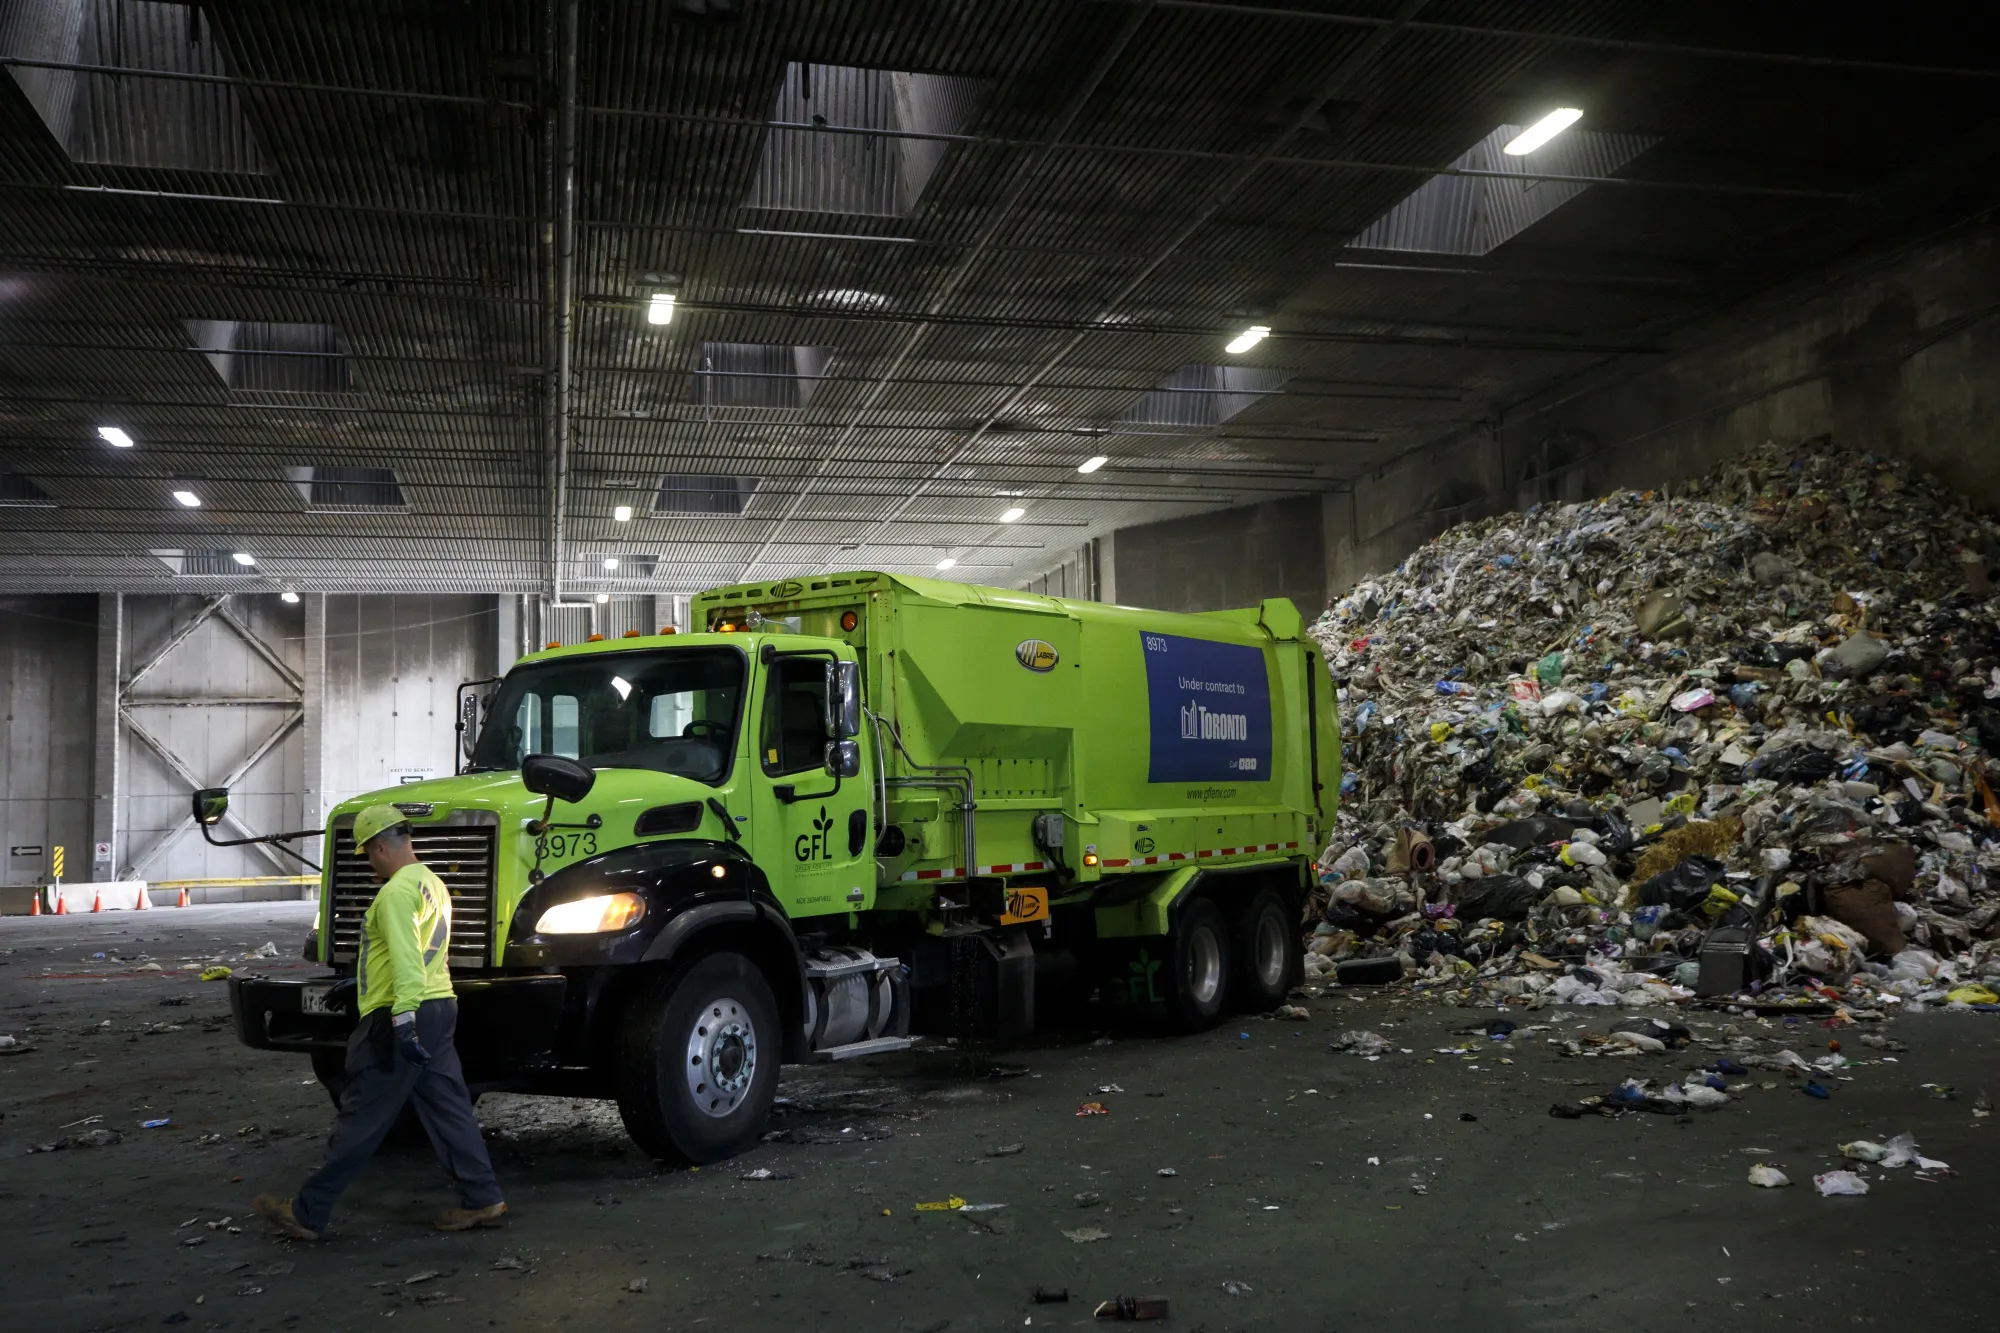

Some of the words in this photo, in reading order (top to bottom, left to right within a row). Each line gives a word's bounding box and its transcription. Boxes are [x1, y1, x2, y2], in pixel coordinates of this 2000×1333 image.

[1146, 636, 1168, 652] 8973
[1178, 676, 1203, 691] Under
[1205, 682, 1236, 694] contract
[1236, 684, 1245, 695] to
[1198, 706, 1247, 741] TORONTO
[535, 832, 598, 860] 8973
